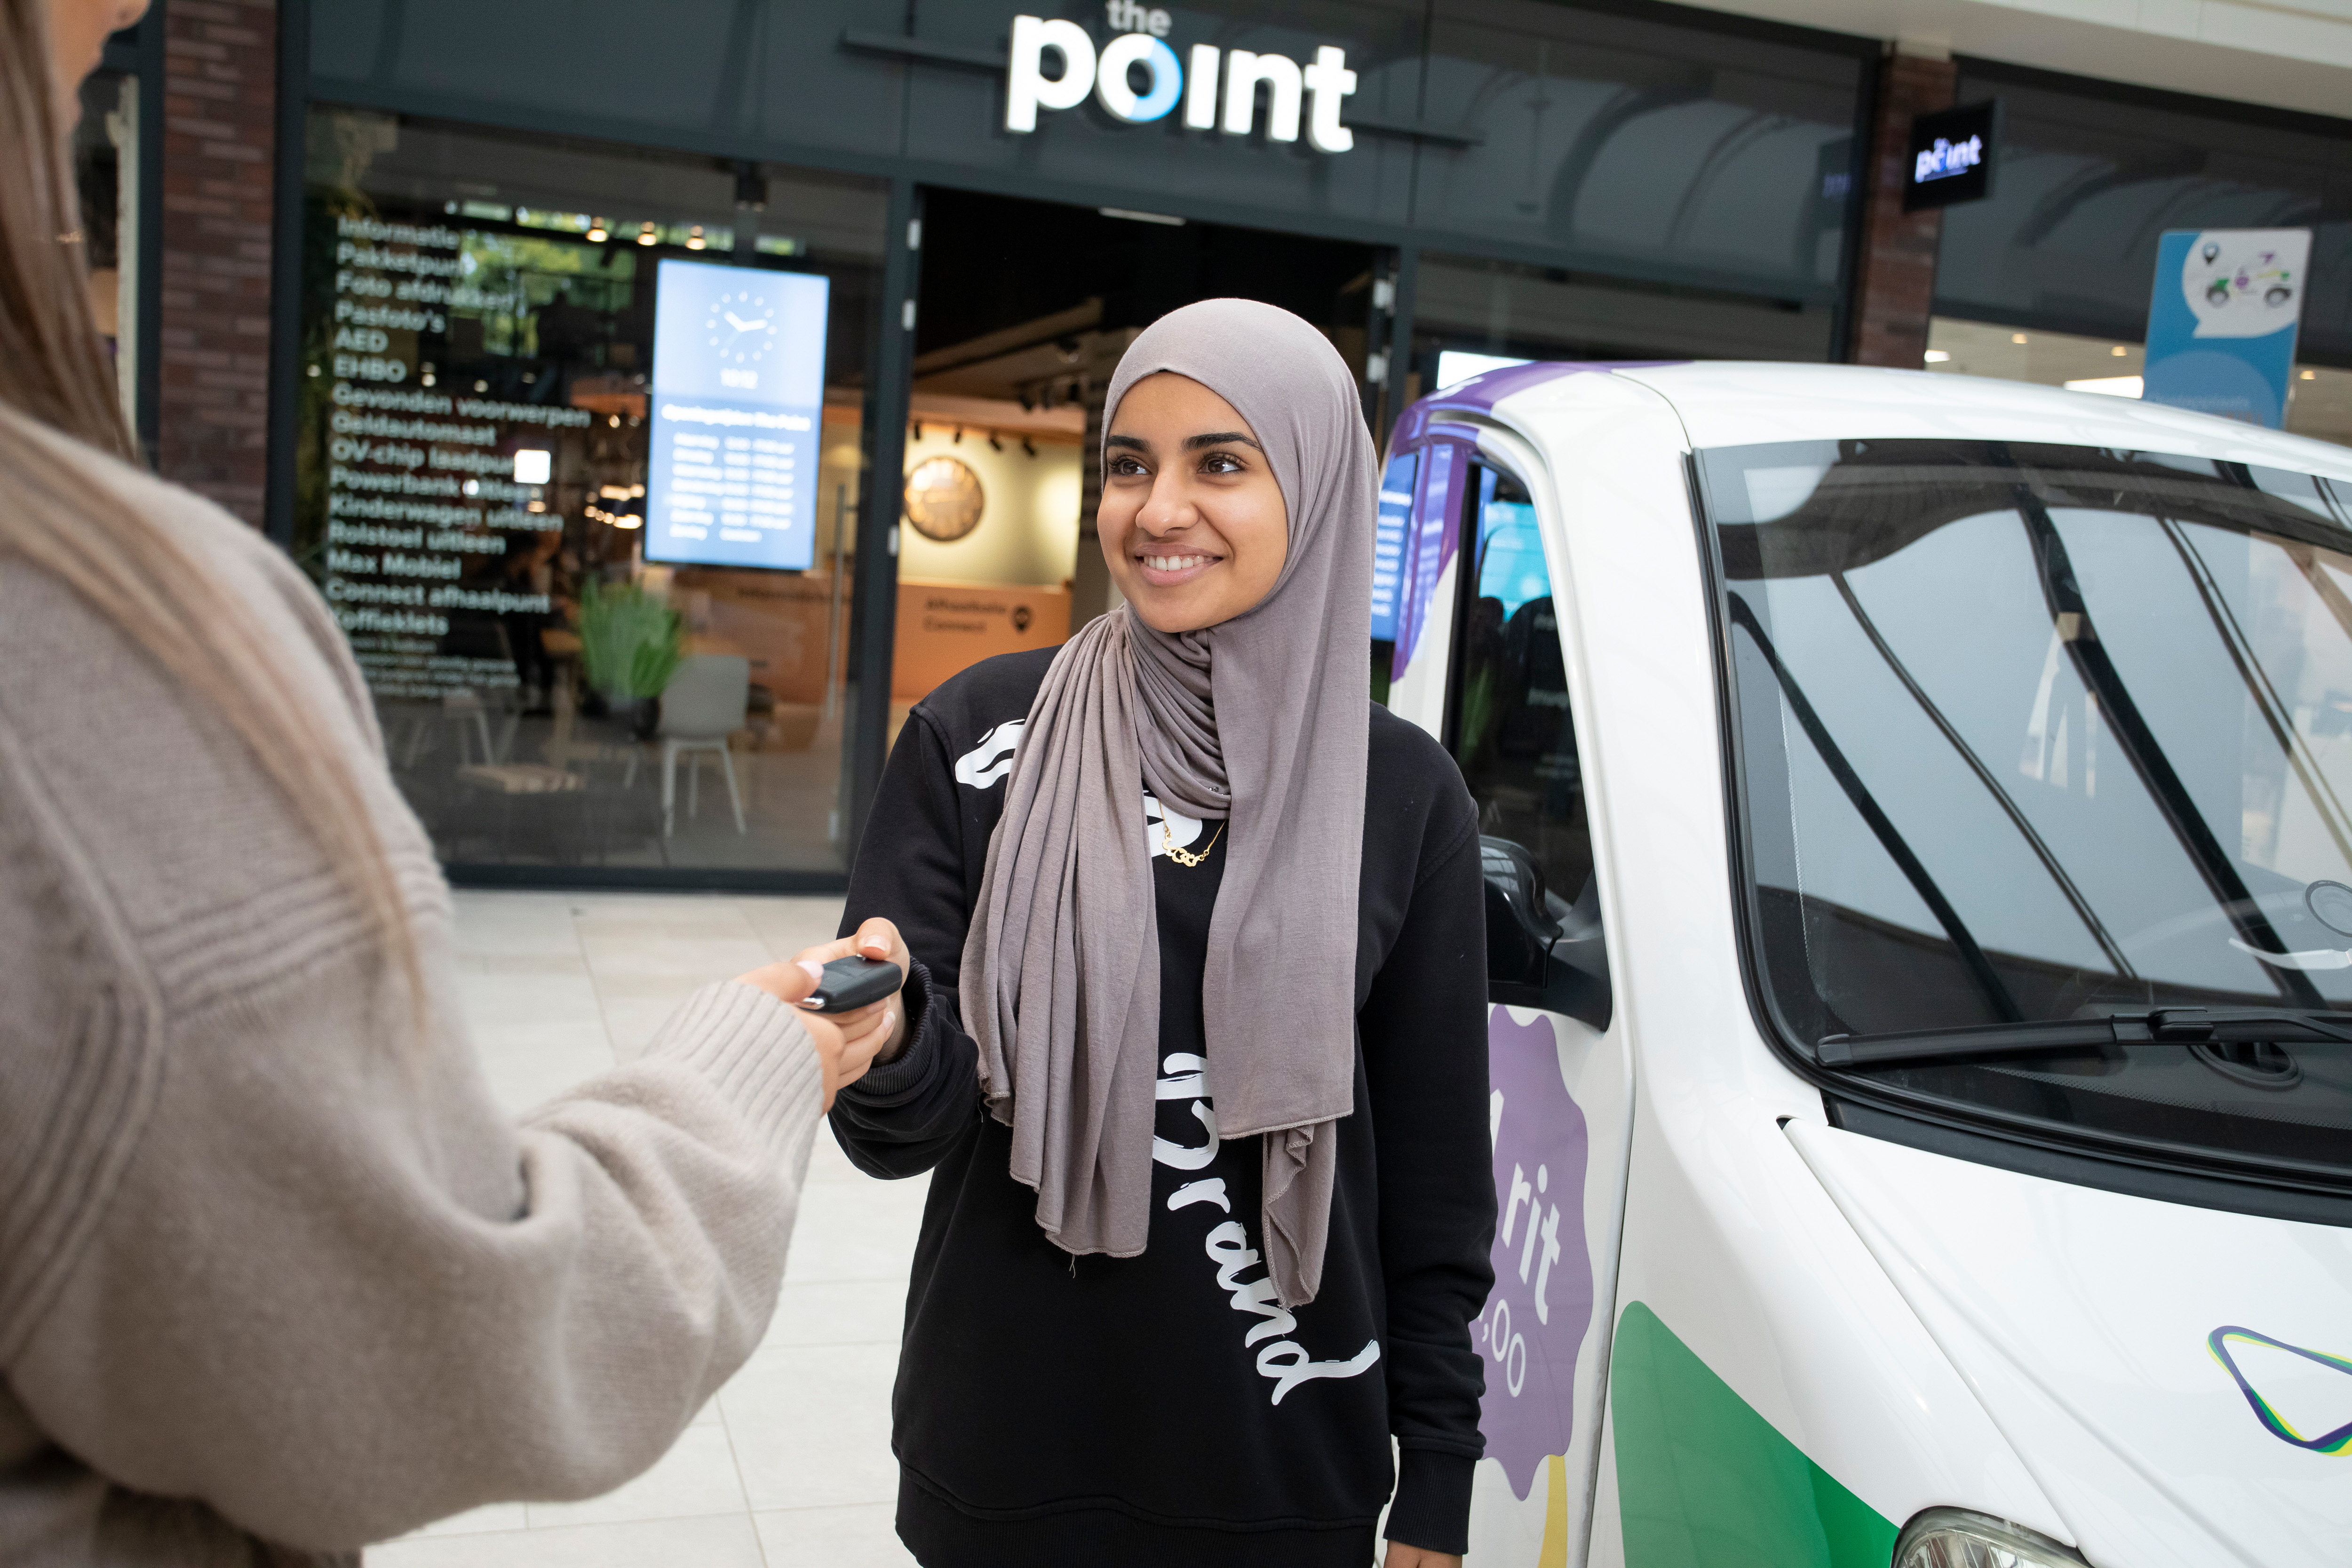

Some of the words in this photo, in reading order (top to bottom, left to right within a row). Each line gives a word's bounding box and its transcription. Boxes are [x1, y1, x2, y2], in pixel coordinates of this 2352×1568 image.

[1106, 0, 1172, 37] the
[1005, 14, 1358, 153] point
[1914, 134, 1982, 183] point
[338, 215, 459, 249] Informatie
[336, 269, 392, 297] Foto
[335, 299, 445, 333] Pasfoto's
[333, 326, 389, 352] AED
[333, 354, 407, 382] EHBO
[332, 382, 453, 415] Gevonden
[456, 396, 591, 429] voorwerpen
[332, 410, 497, 446] Geldautomaat
[331, 437, 425, 470] OV-chip
[330, 465, 461, 497] Powerbank
[330, 493, 482, 528] Kinderwagen
[486, 506, 564, 532] uitleen
[329, 520, 423, 549] Rolstoel
[426, 529, 506, 555] uitleen
[328, 549, 377, 573] Max
[381, 551, 462, 580] Mobiel
[326, 576, 425, 606] Connect
[429, 584, 550, 615] afhaalpunt
[1478, 1298, 1526, 1398] ,00
